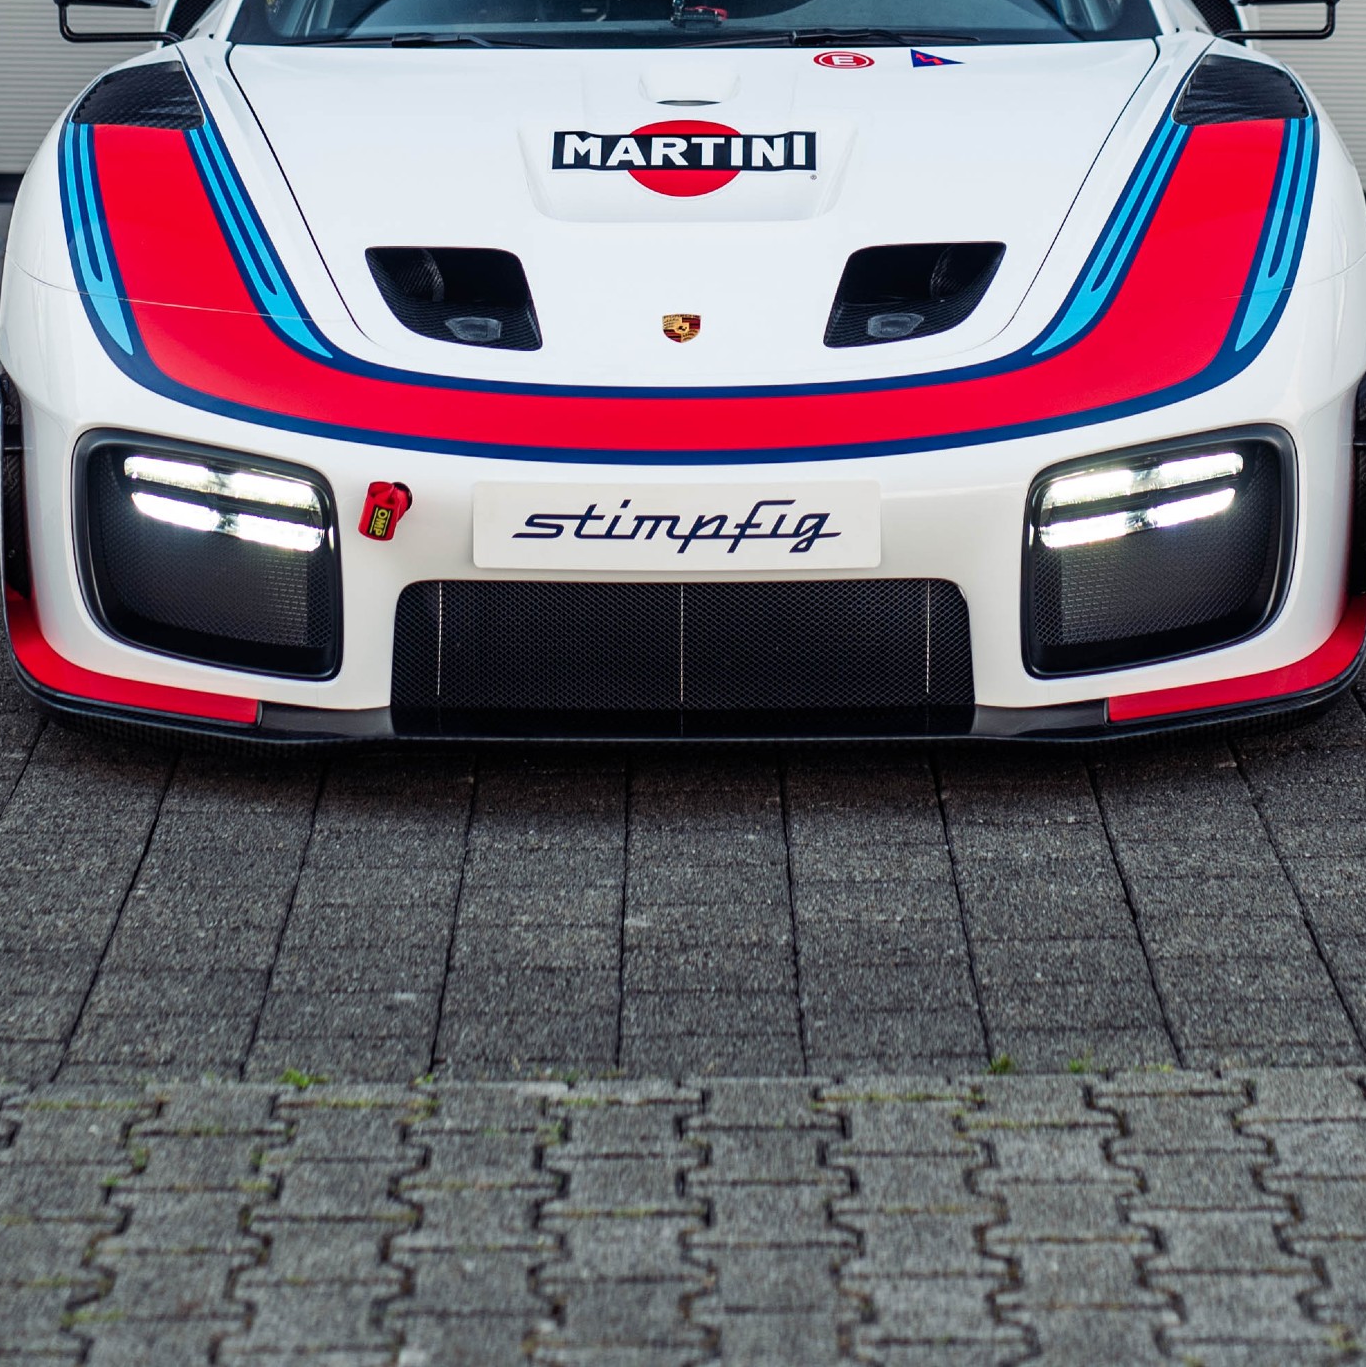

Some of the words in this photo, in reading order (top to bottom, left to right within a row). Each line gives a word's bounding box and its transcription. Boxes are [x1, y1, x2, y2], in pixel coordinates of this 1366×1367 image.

[831, 55, 858, 66] E
[562, 134, 806, 167] MARTINI
[373, 508, 389, 536] OMP
[511, 499, 842, 554] stimpfig
